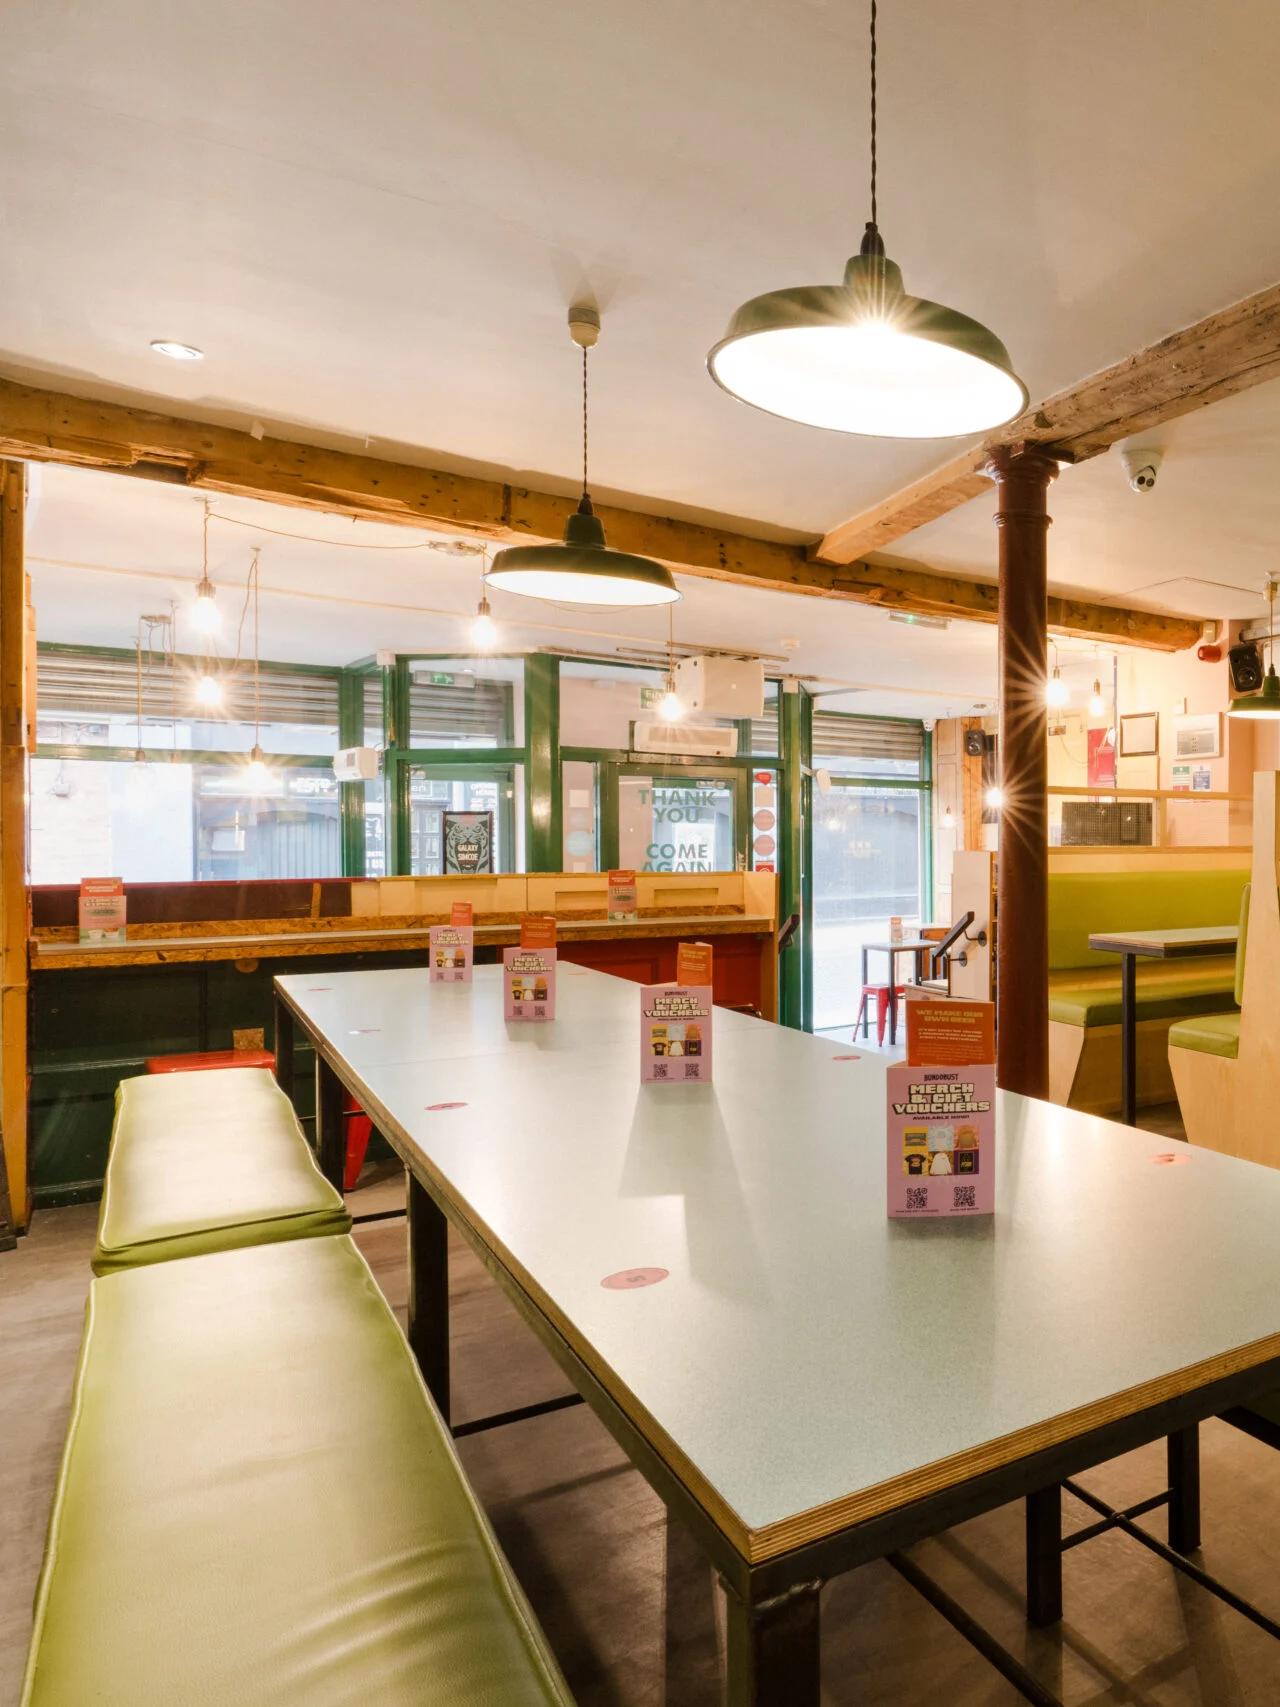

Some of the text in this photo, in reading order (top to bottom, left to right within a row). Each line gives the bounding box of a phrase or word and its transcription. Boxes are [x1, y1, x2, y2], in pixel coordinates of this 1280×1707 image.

[638, 789, 716, 806] THANK
[653, 807, 699, 824] YOU
[457, 844, 479, 852] GALAXY
[646, 843, 708, 859] COME
[654, 997, 698, 1005] MERCH
[644, 1009, 709, 1018] VOUCHERS
[923, 1073, 959, 1081] BUNDOBUST
[909, 1083, 974, 1095] MERCH
[932, 1092, 974, 1103] GIFT
[892, 1101, 991, 1115] VOUCHERS
